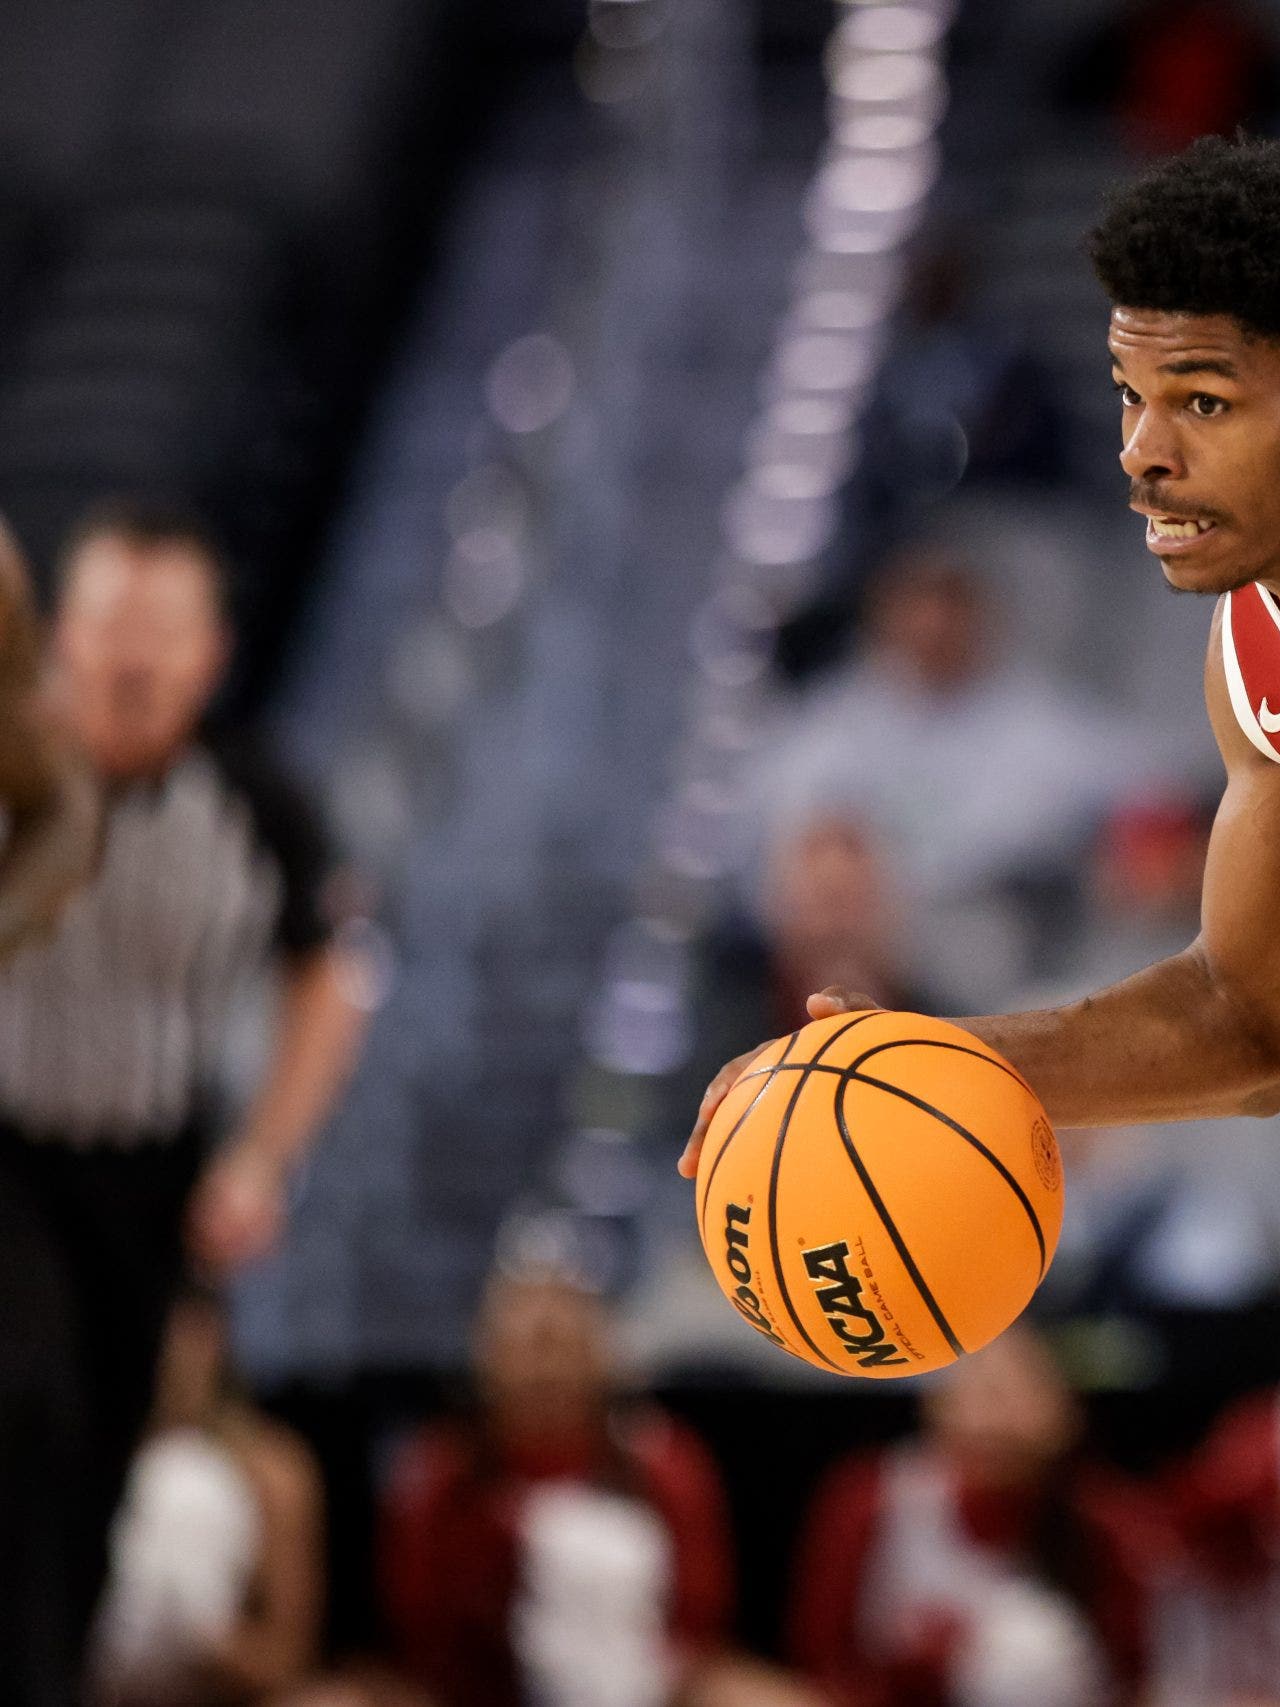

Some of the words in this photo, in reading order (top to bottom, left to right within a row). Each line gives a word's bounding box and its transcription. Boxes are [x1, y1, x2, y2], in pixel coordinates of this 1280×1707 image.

[855, 1235, 873, 1278] BALL
[800, 1239, 912, 1369] NCAA
[869, 1281, 894, 1321] GAME
